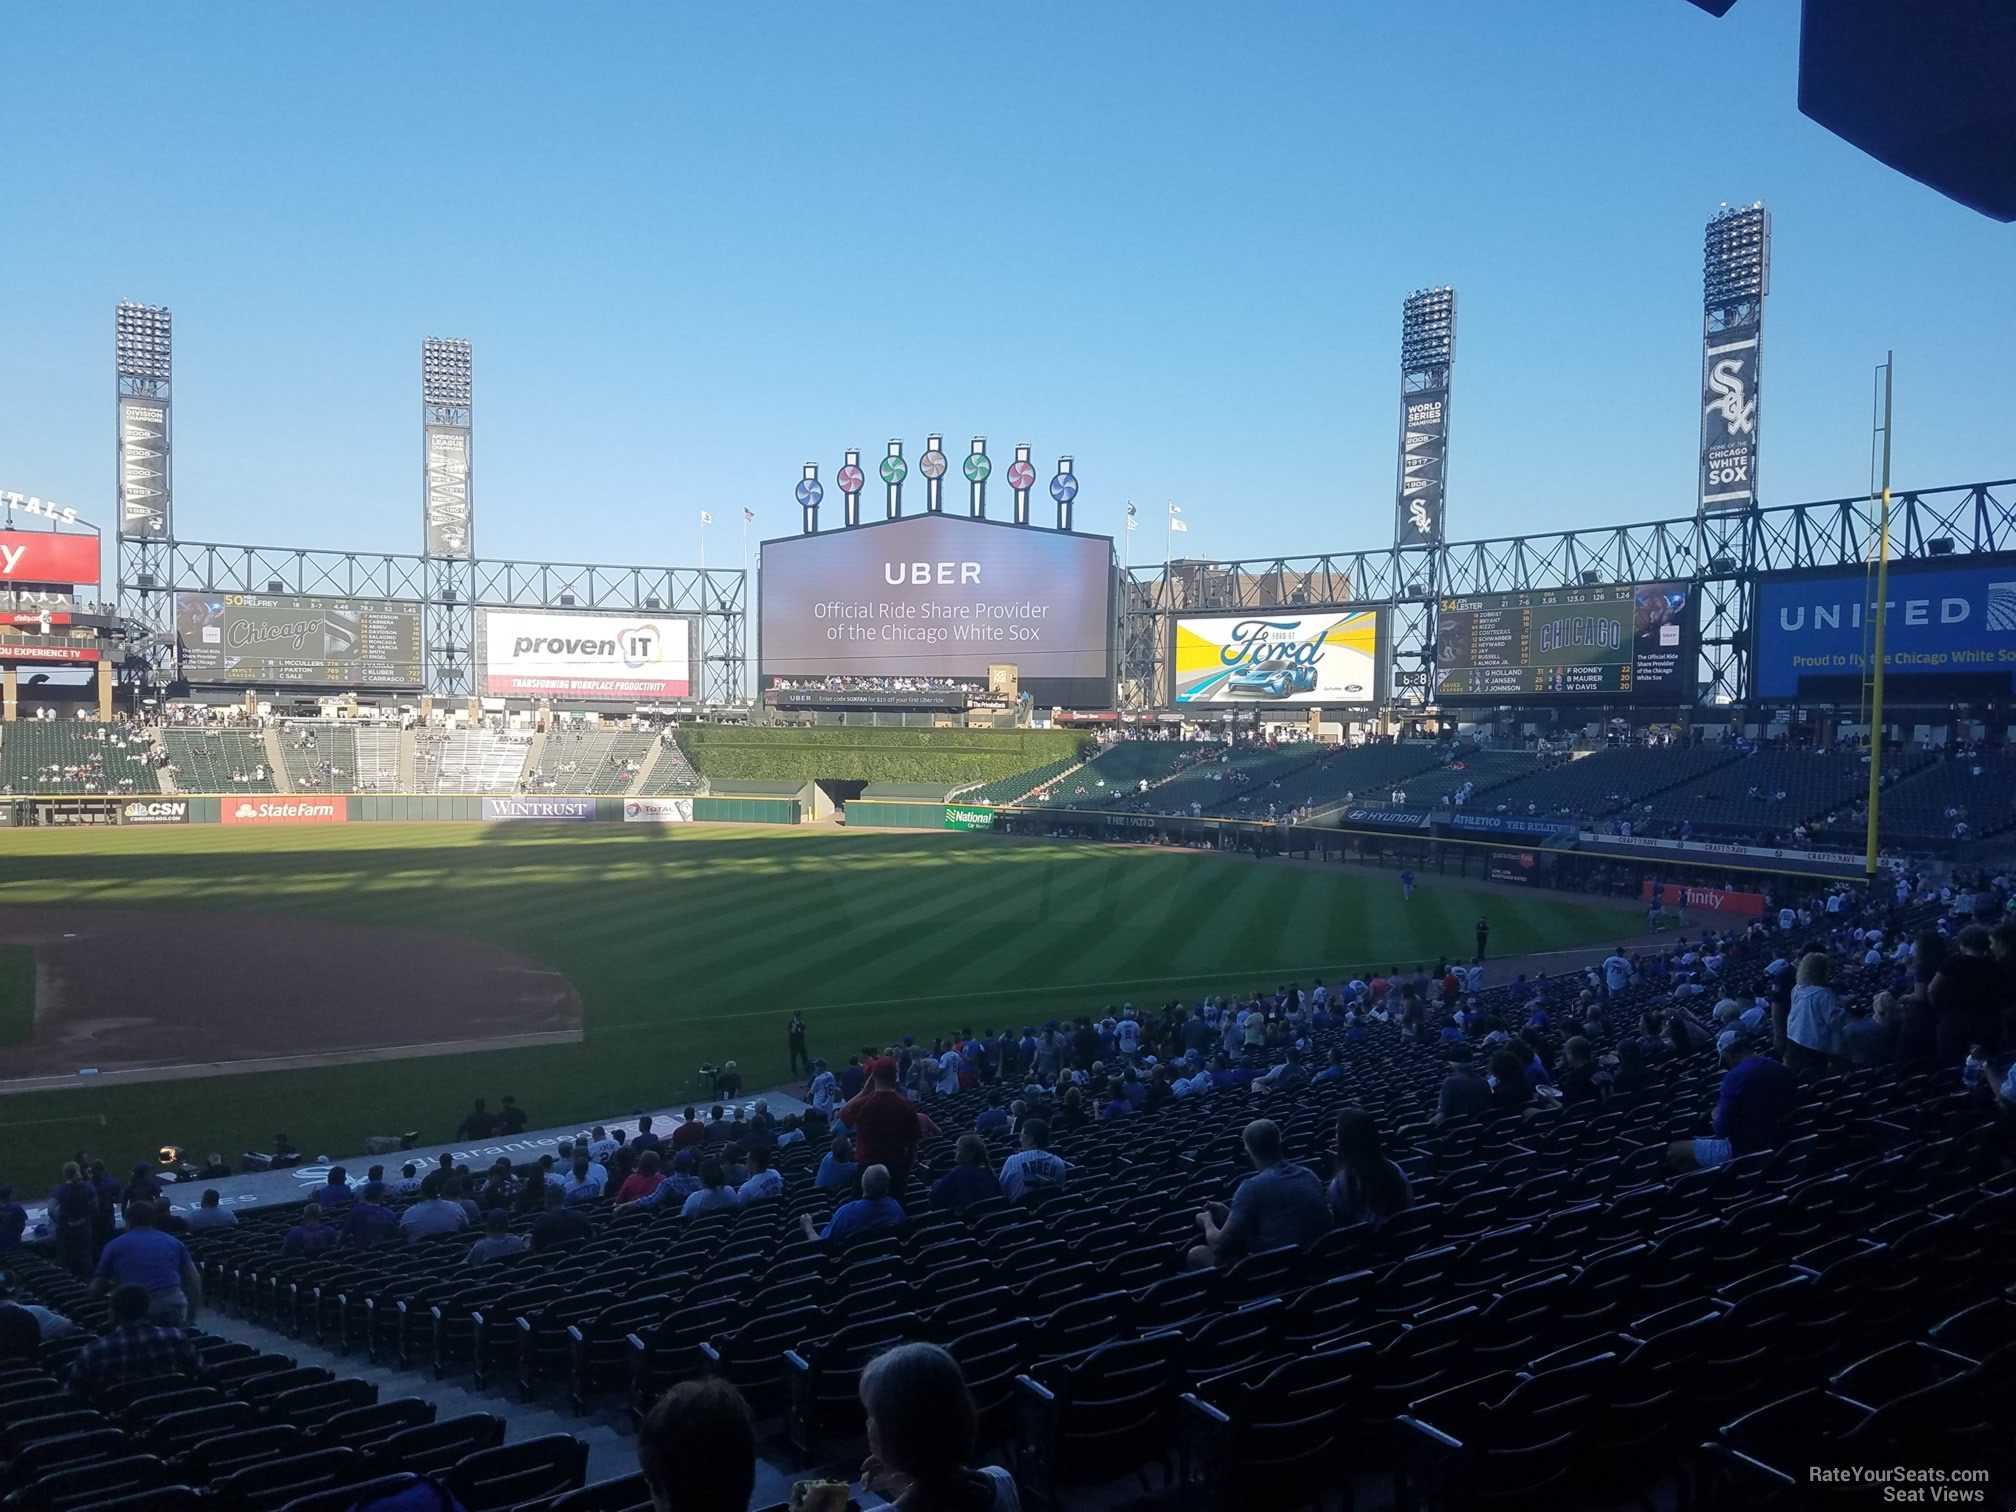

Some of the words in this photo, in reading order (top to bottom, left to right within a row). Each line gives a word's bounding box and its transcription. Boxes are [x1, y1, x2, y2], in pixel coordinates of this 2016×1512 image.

[1408, 402, 1441, 413] WORLD
[126, 410, 162, 418] DIVISION
[1408, 410, 1441, 422] SERIES
[1408, 419, 1440, 427] CHAMPIONS
[432, 439, 464, 447] LEAGUE
[1709, 442, 1726, 451] HOME
[1709, 448, 1748, 459] CHICAGO
[1709, 456, 1747, 469] WHITE
[1709, 466, 1747, 485] SOX
[0, 490, 77, 524] TALS
[885, 562, 981, 585] UBER
[225, 595, 243, 605] 50
[1441, 600, 1456, 611] 34
[814, 602, 874, 619] Official
[880, 602, 916, 618] Ride
[921, 602, 971, 619] Share
[976, 601, 1049, 618] Provider
[1780, 597, 1970, 631] UNITED
[227, 618, 323, 650] Chicago
[827, 624, 842, 640] of
[848, 624, 876, 640] the
[881, 623, 948, 644] Chicago
[953, 623, 1004, 640] White
[1008, 624, 1040, 641] Sox
[1540, 617, 1621, 652] CHICAGO
[513, 634, 615, 658] proven
[631, 638, 652, 657] IT
[1220, 620, 1328, 666] Ford
[14, 646, 68, 657] EXPERIENCE
[70, 650, 81, 658] TV
[1793, 655, 1829, 667] Proud
[1833, 655, 1846, 666] to
[1849, 654, 1865, 667] fly
[1895, 651, 1947, 666] Chicago
[1952, 649, 1994, 663] White
[1998, 649, 2016, 662] So
[512, 679, 569, 688] TRANSFORMING
[571, 680, 614, 690] WORKPLACE
[615, 681, 665, 691] PRODUCTIVITY
[1403, 674, 1426, 684] 6:28
[147, 803, 186, 816] CSN
[491, 800, 587, 816] WINTRUST
[644, 805, 674, 813] TOTAL
[955, 812, 992, 824] National
[1367, 812, 1421, 824] HYUNDAI
[1453, 814, 1501, 827] ATHLETICO
[1506, 821, 1525, 831] THE
[1619, 837, 1638, 845] CRAFT
[1705, 844, 1725, 853] CRAFT
[1807, 853, 1830, 861] CRAFT
[1611, 965, 1622, 974] 79
